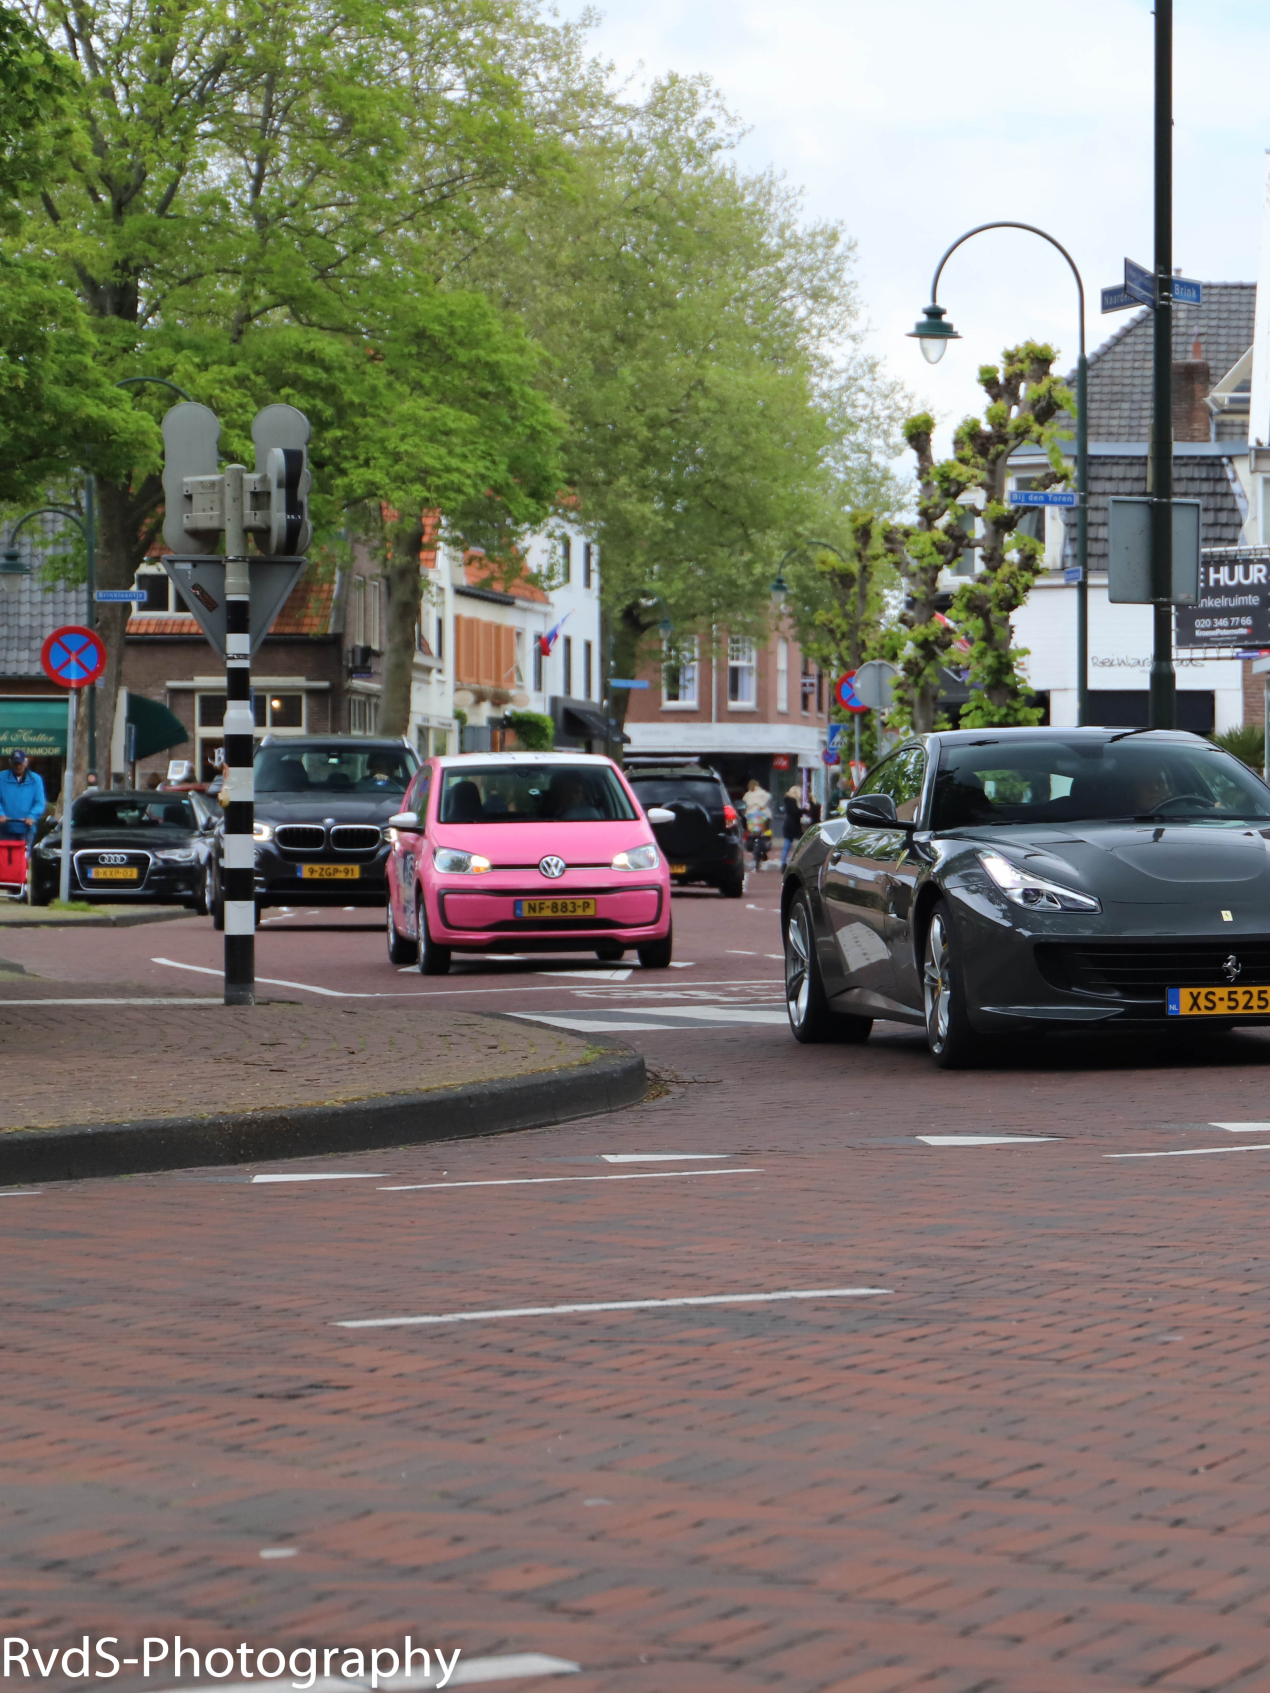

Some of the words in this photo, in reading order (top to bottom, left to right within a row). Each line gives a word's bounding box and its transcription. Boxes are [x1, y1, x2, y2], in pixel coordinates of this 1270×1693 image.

[1174, 284, 1196, 298] Brink
[1012, 493, 1025, 502] Bij
[1048, 494, 1072, 502] Toren
[1209, 564, 1267, 586] HUUR
[1189, 594, 1260, 608] nkelruimte
[1195, 618, 1212, 628] 020
[1213, 617, 1229, 628] 346
[1230, 616, 1240, 626] 77
[1241, 616, 1253, 626] 66
[307, 867, 354, 877] 9-ZGP-91
[527, 901, 591, 914] NF-883-P
